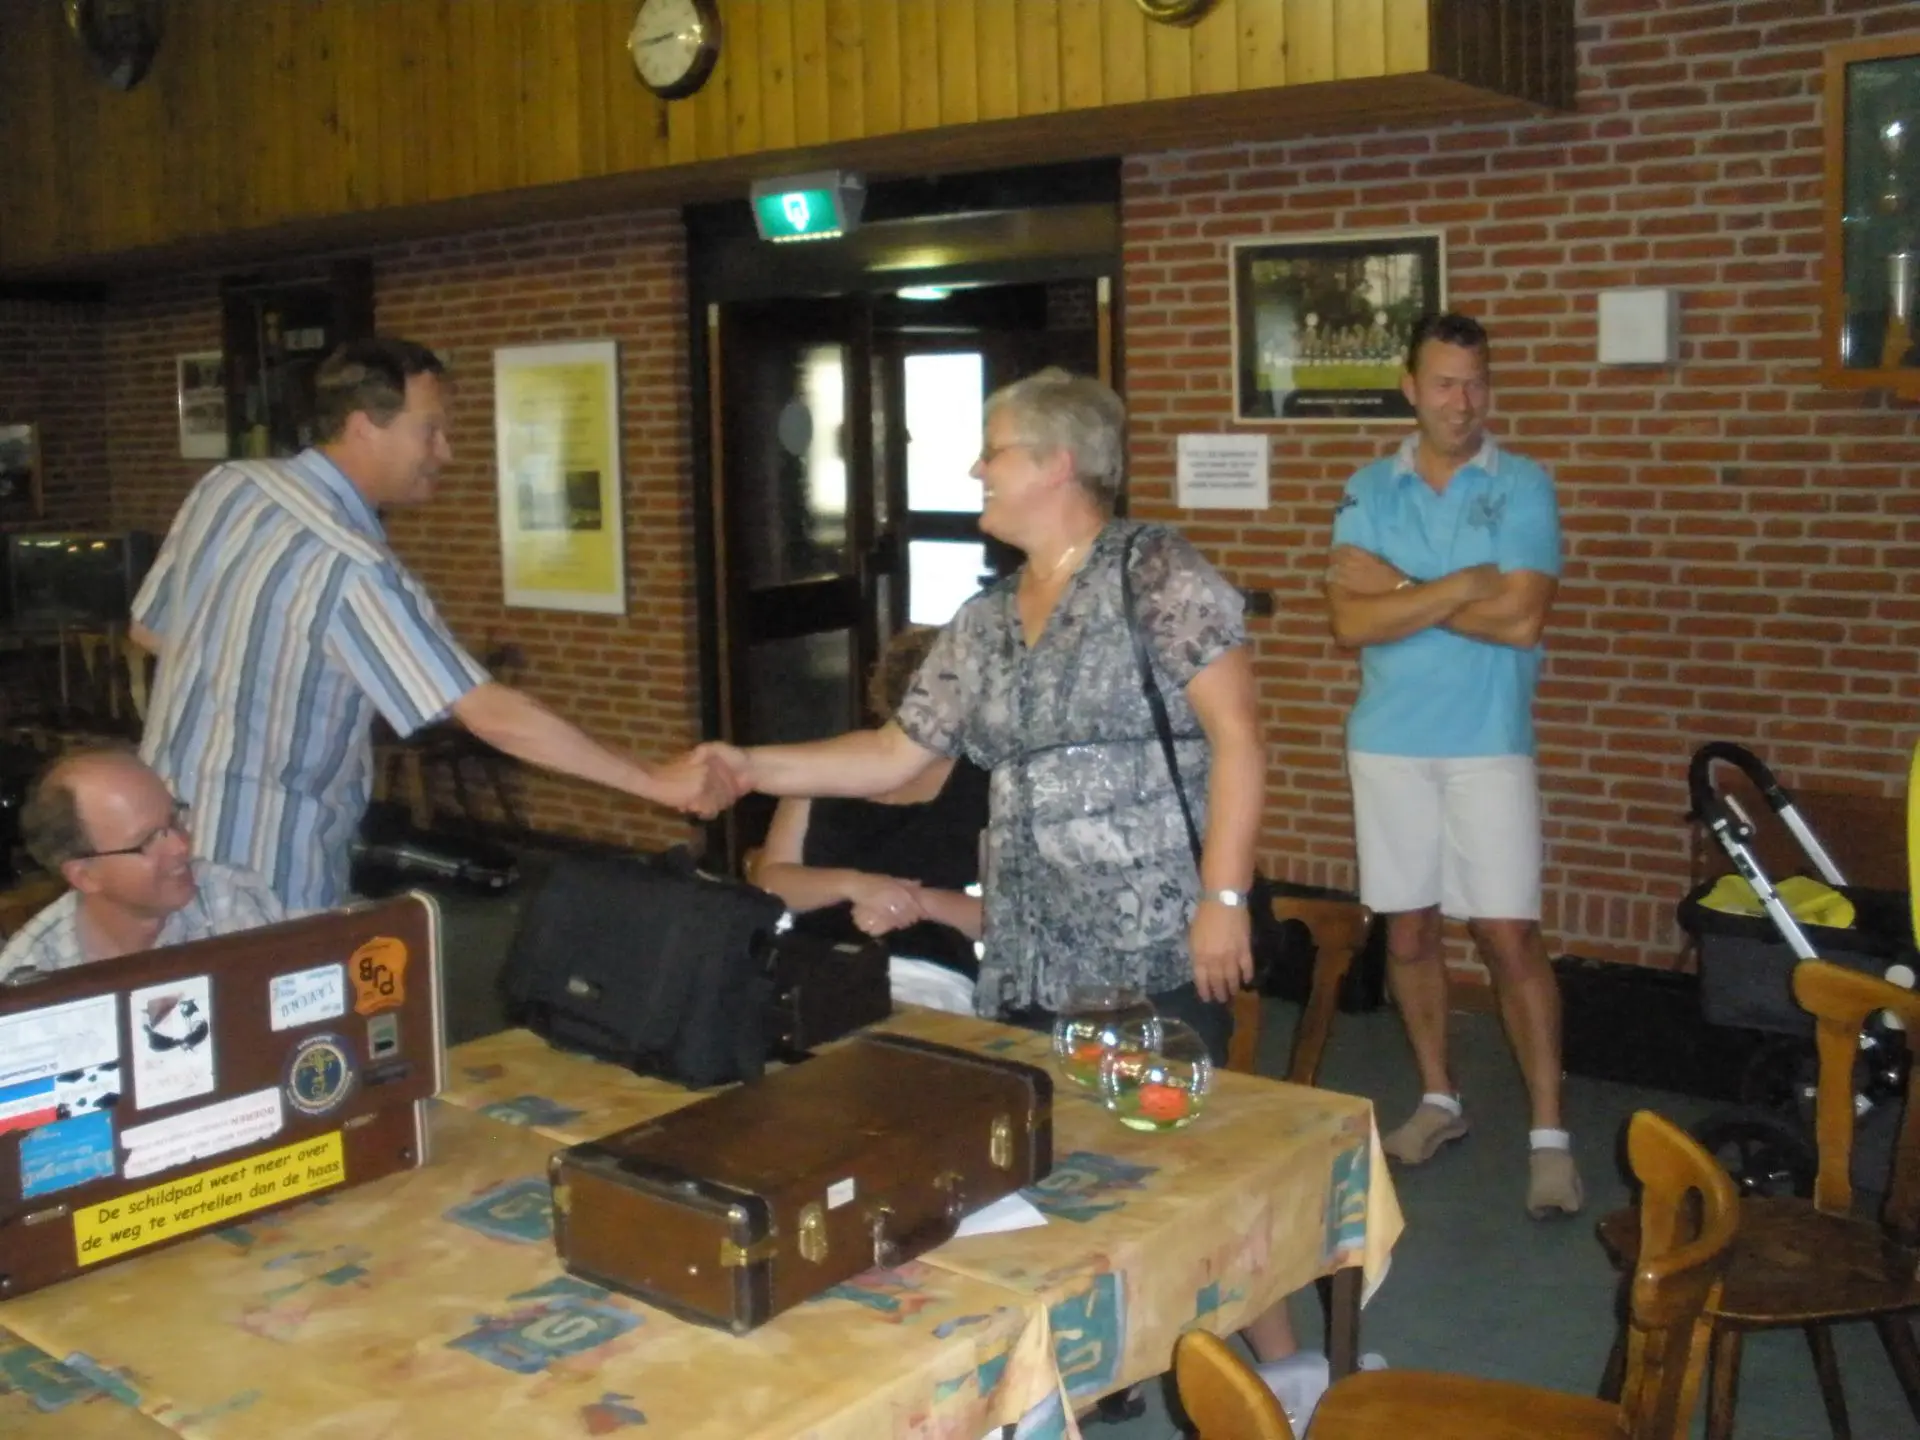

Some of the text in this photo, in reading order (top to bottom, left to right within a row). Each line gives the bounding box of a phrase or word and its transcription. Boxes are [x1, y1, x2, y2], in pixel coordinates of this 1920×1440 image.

[359, 957, 395, 996] PJB
[81, 1233, 102, 1252] de
[110, 1223, 141, 1241] weg
[149, 1213, 166, 1230] te
[174, 1191, 243, 1221] vertellen
[249, 1180, 276, 1199] dan
[282, 1172, 300, 1188] de
[307, 1160, 340, 1179] haas
[98, 1206, 120, 1225] De
[128, 1178, 203, 1214] schildpad
[209, 1167, 247, 1189] weet
[253, 1154, 292, 1175] meer
[297, 1141, 329, 1162] over
